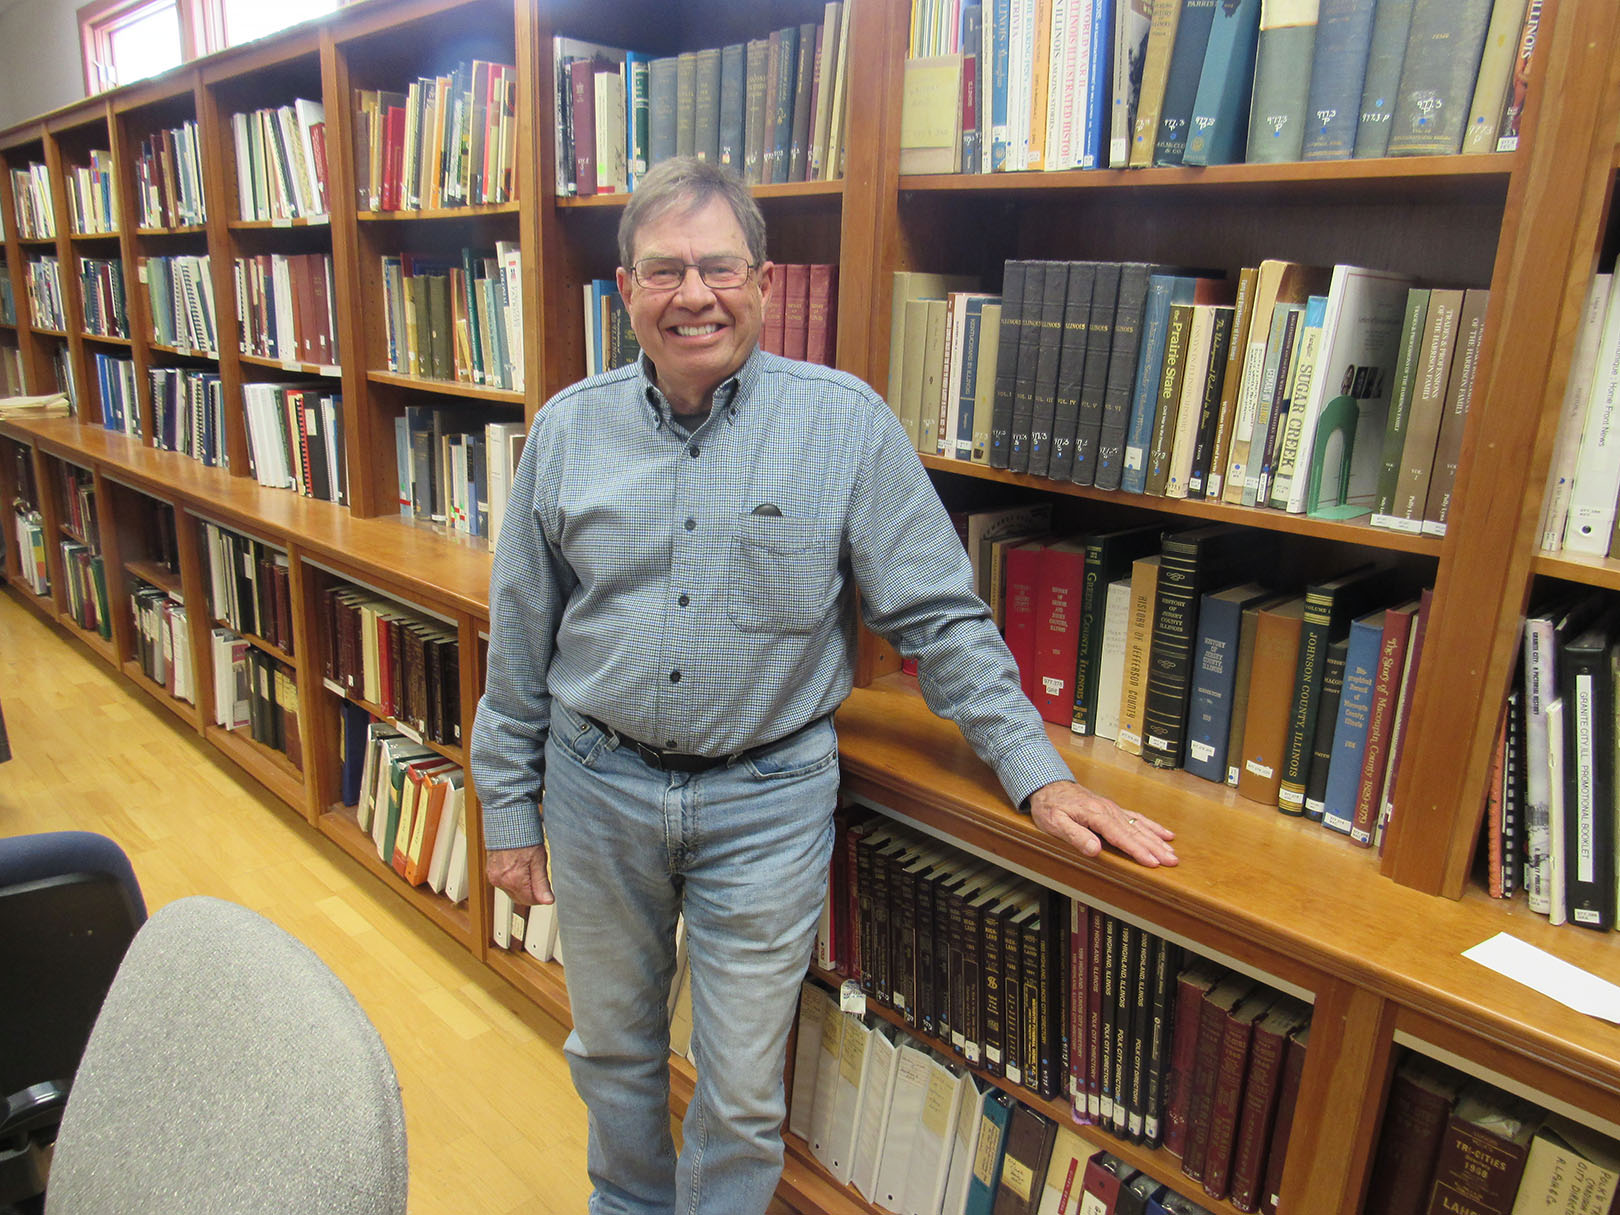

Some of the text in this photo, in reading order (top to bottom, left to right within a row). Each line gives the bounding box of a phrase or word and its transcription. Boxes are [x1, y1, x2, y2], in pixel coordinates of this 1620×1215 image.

[1052, 9, 1063, 57] ILLINOIS
[1081, 4, 1092, 46] WORLD
[1079, 50, 1089, 77] WAR
[1063, 47, 1076, 118] ILLUSTRATED
[1440, 309, 1454, 341] TRADES
[1166, 322, 1182, 366] Prairie
[1422, 304, 1445, 401] OF THE HARRISON FAMILY
[1162, 367, 1176, 399] State
[1431, 348, 1447, 399] PROFESSIONS
[1454, 318, 1479, 415] OF THE HARRISON FAMILY
[1290, 364, 1313, 414] SUGAR
[1220, 400, 1228, 423] William
[1598, 382, 1616, 447] Home Front News
[1216, 424, 1225, 443] Wilson
[1281, 418, 1303, 469] CREEK
[1162, 598, 1186, 607] HISTORY
[1160, 623, 1183, 632] ILLINOIS
[1161, 617, 1183, 626] COUNTY
[1126, 596, 1148, 719] HISTORY OF JEFFERSON COUNTY
[1204, 637, 1226, 648] HISTORY
[1289, 632, 1318, 777] JOHNSON COUNTY, ILLINOIS
[1579, 691, 1589, 726] GRANITE
[1358, 638, 1398, 824] The Story of Macoupin County 1829-1979
[1580, 765, 1589, 821] PROMOTIONAL
[1581, 822, 1590, 860] BOOKLET
[1120, 943, 1128, 979] HIGHLAND,
[1138, 948, 1147, 980] HIGHLAND,
[1118, 980, 1126, 1008] ILLINOIS
[1137, 981, 1145, 1007] ILLINOIS
[1103, 1023, 1111, 1039] POLK
[1134, 1038, 1142, 1055] POLK
[1132, 1070, 1140, 1105] DIRECTORY
[1456, 1140, 1506, 1171] TRI-CITIES
